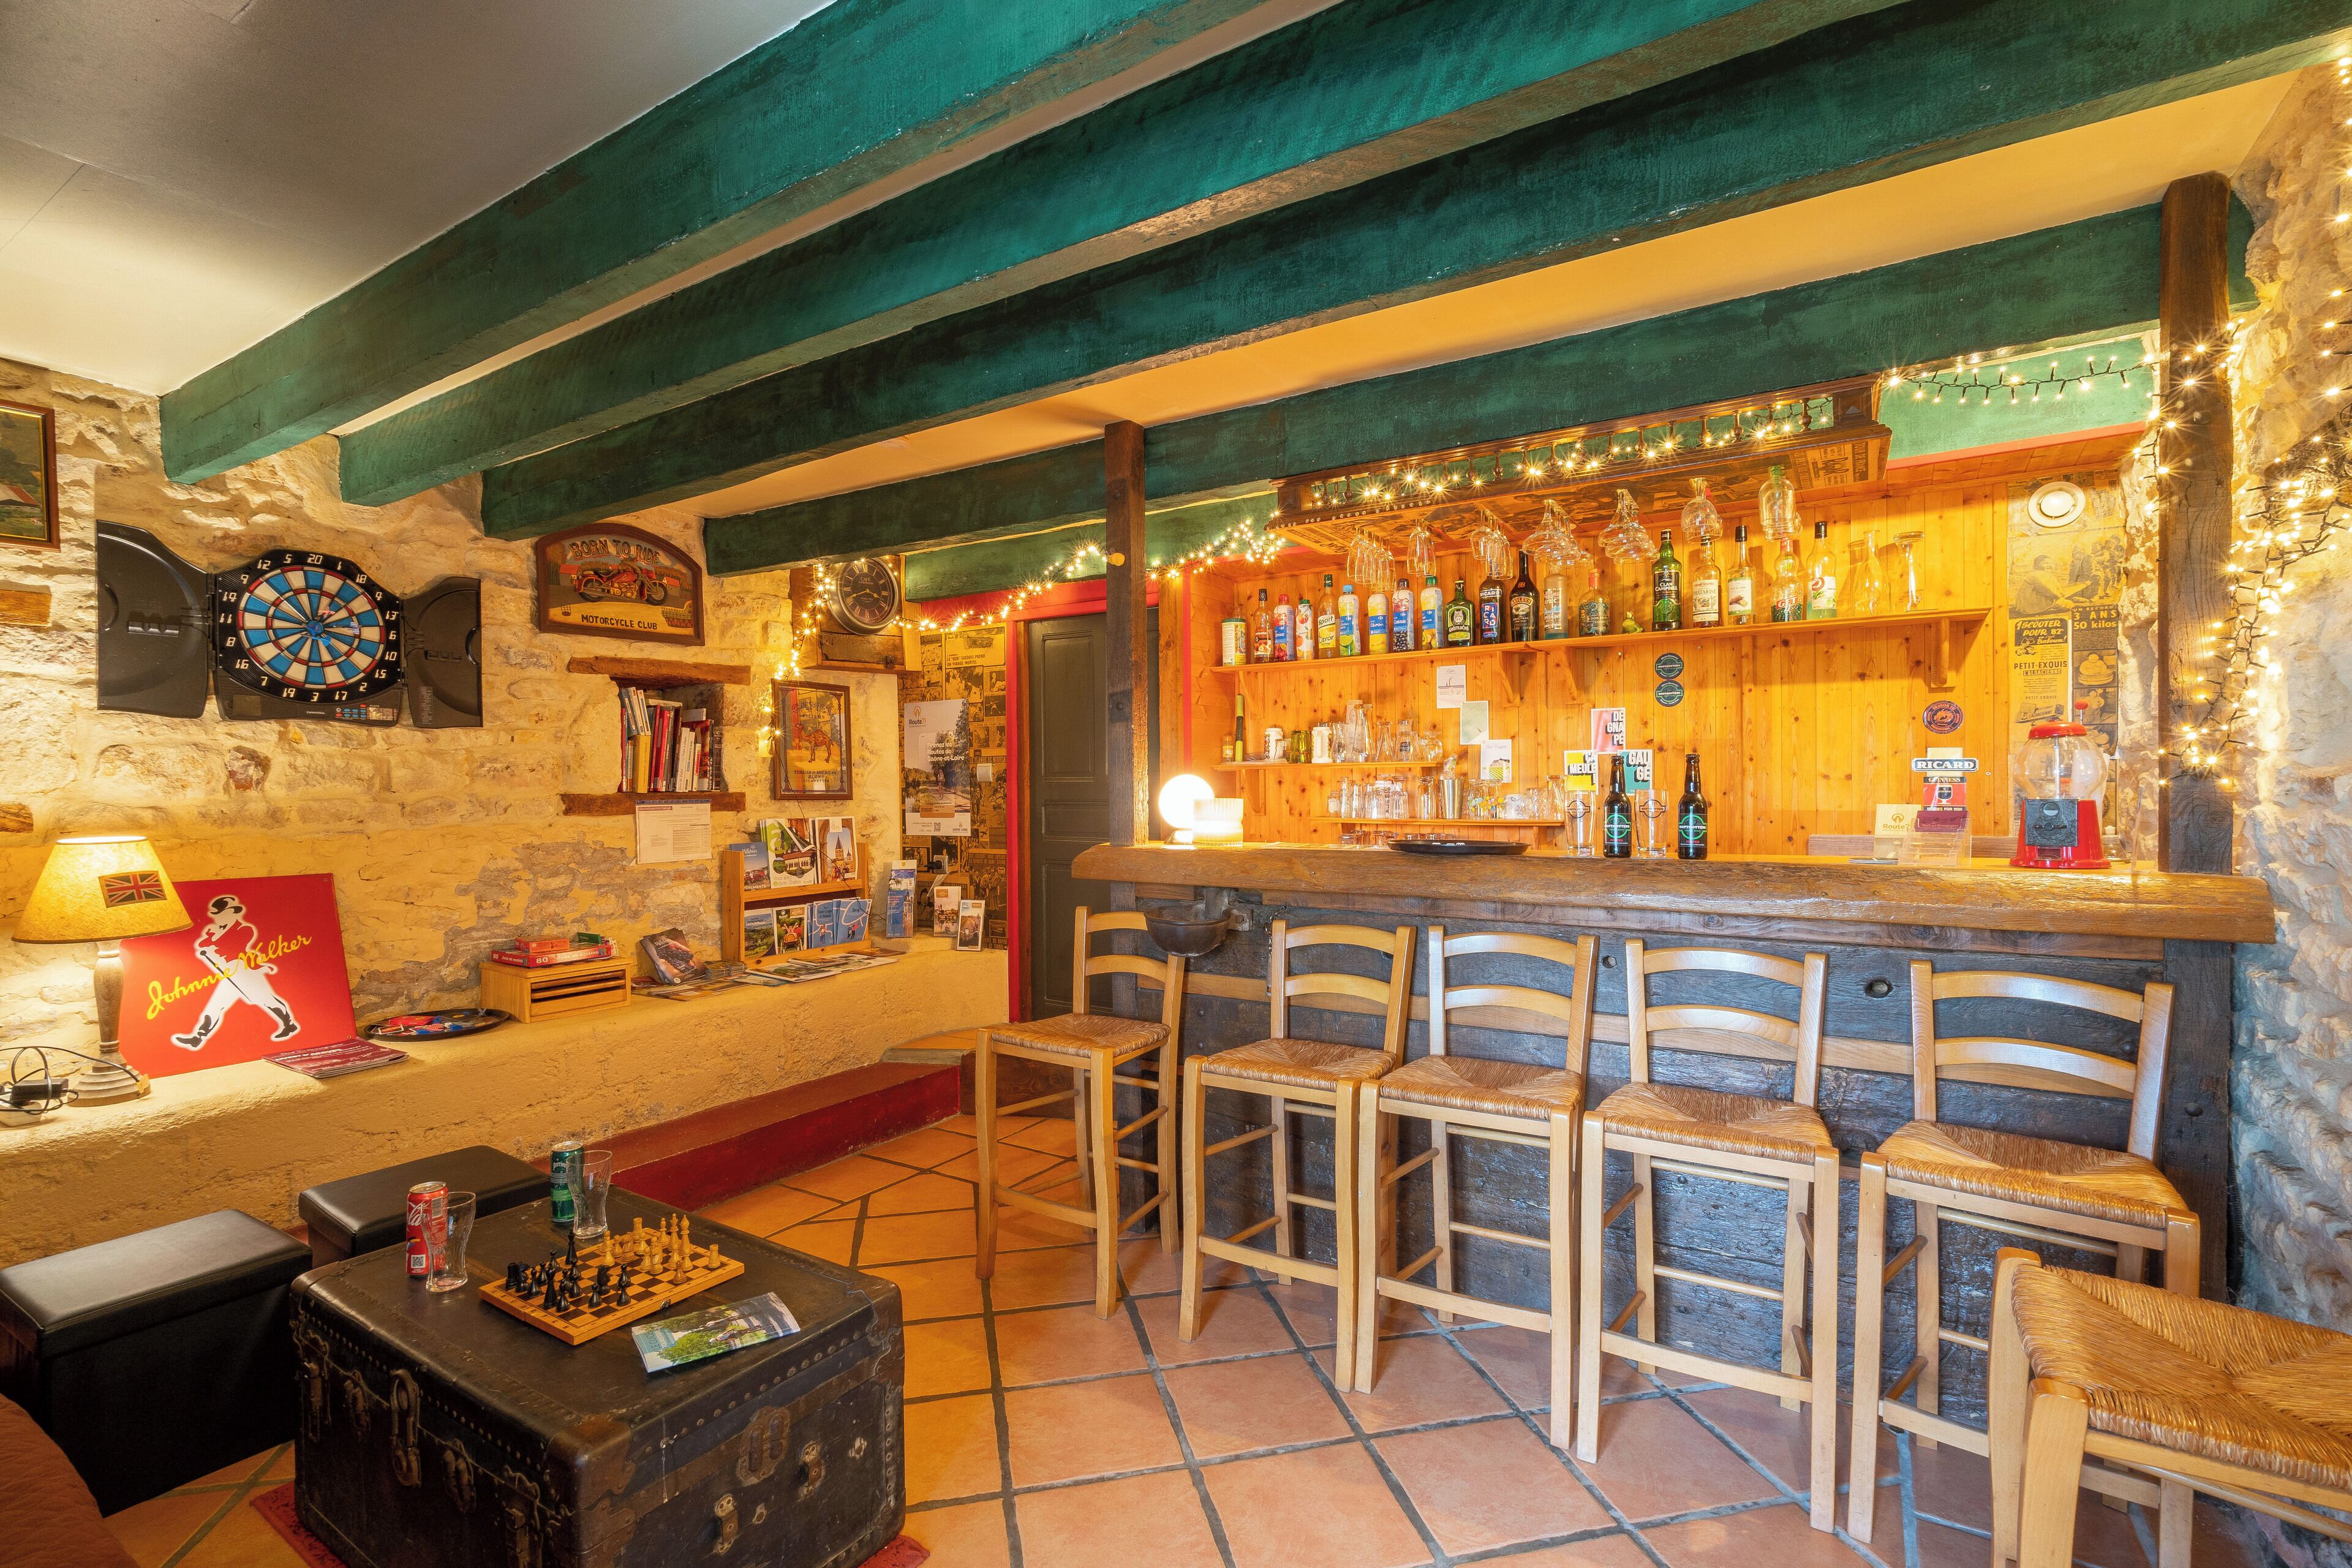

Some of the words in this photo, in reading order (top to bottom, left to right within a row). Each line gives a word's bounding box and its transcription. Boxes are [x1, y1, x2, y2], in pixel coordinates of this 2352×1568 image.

[569, 539, 610, 560] BORN
[612, 540, 631, 557] TO
[635, 545, 660, 566] RIDE
[284, 554, 293, 564] 5
[307, 554, 323, 564] 20
[257, 559, 271, 570] 12
[337, 561, 342, 570] 1
[241, 575, 249, 584] 9
[356, 574, 367, 584] 18
[223, 592, 237, 601] 14
[375, 592, 382, 600] 4
[1511, 597, 1533, 605] BAILEYS
[1777, 597, 1797, 608] GET
[219, 614, 232, 623] 11
[386, 611, 397, 620] 13
[581, 614, 635, 628] MOTORCYCLE
[638, 620, 657, 630] CLUB
[1319, 617, 1333, 626] Sport
[2022, 620, 2061, 628] SCOOTER
[2073, 621, 2087, 630] 50
[2091, 620, 2117, 629] kilos
[389, 631, 396, 639] 6
[226, 637, 236, 647] 8
[385, 652, 398, 661] 10
[235, 659, 249, 669] 16
[375, 669, 386, 678] 15
[261, 676, 269, 686] 7
[360, 682, 367, 692] 2
[282, 688, 296, 698] 19
[311, 692, 318, 701] 3
[335, 691, 348, 700] 17
[792, 701, 834, 718] CAMEL
[1613, 709, 1623, 722] DÉ
[1628, 751, 1650, 765] GAU
[1569, 764, 1596, 774] MEULE
[1916, 761, 1975, 769] RICARD
[147, 963, 233, 1019] Johnnie
[237, 935, 312, 970] Walker
